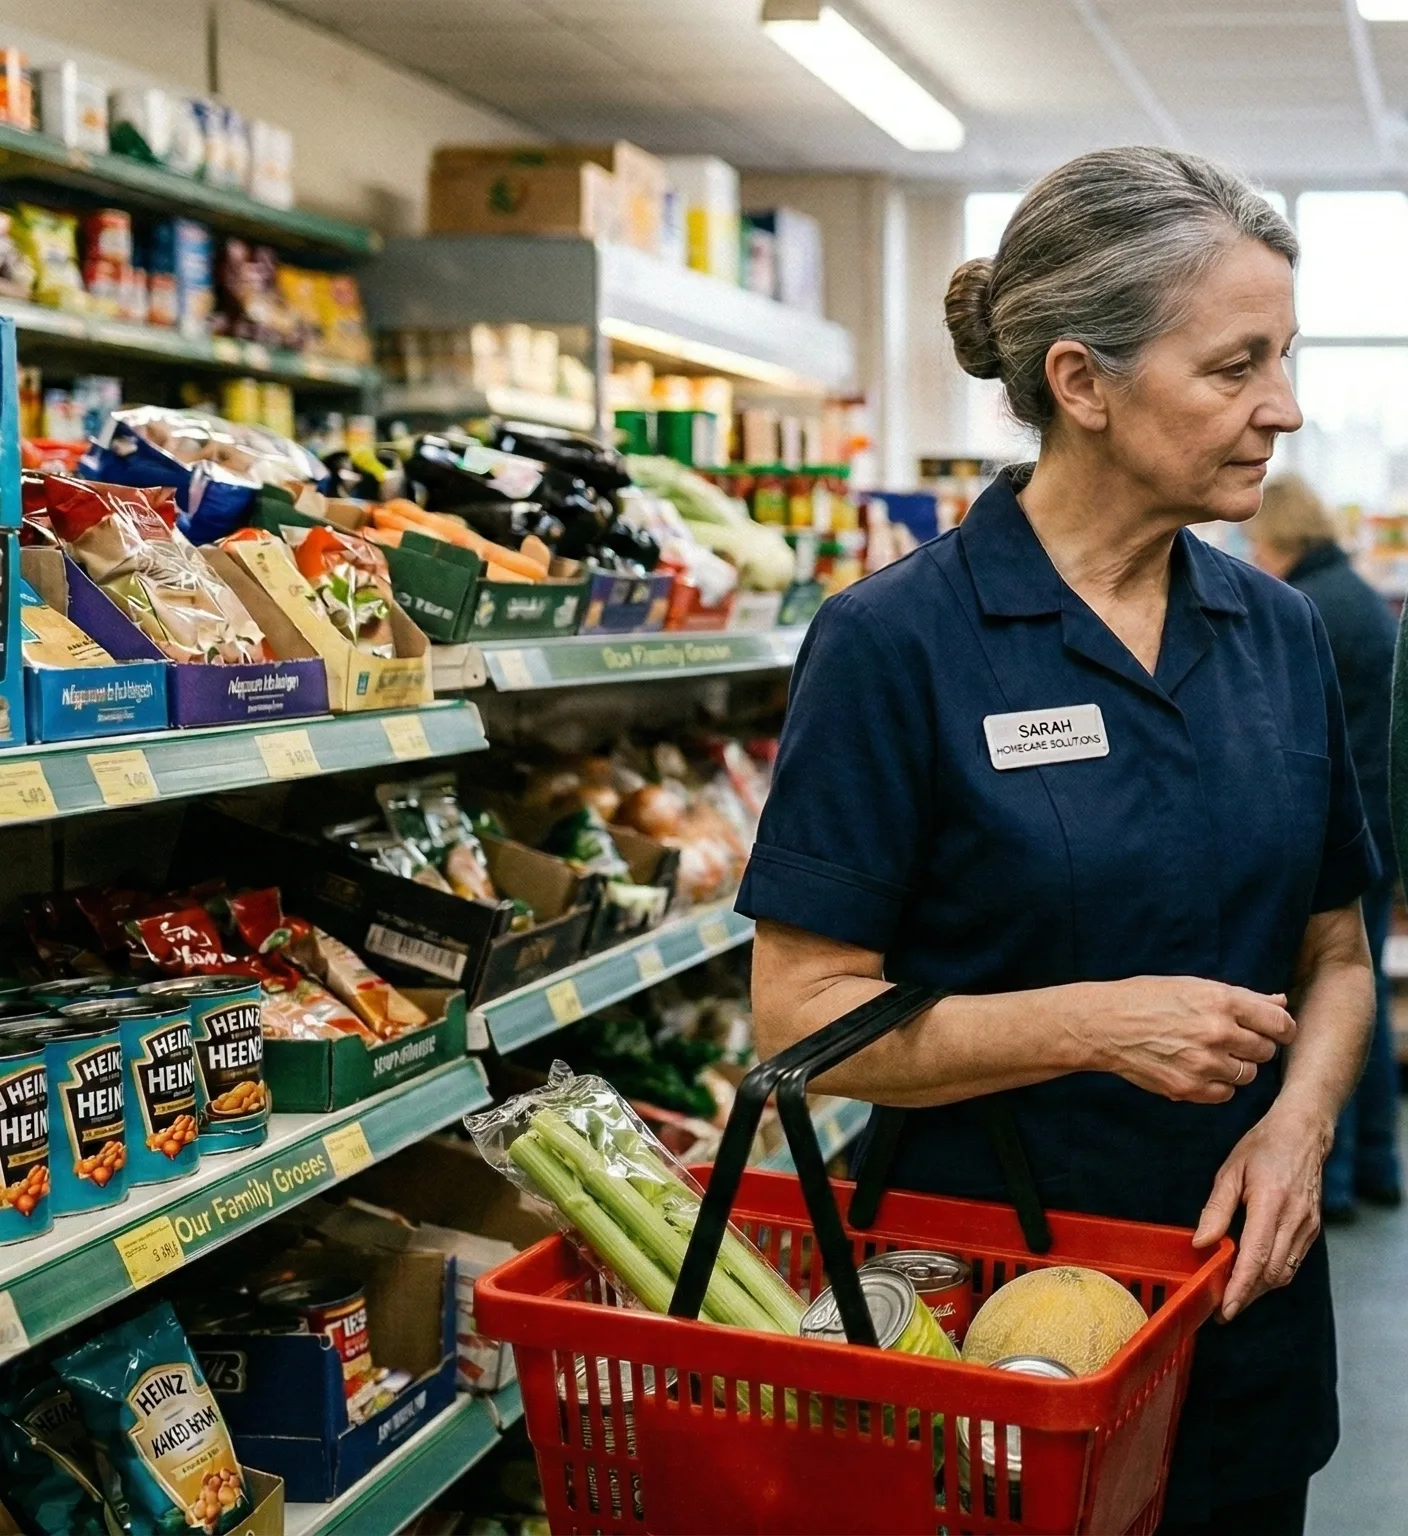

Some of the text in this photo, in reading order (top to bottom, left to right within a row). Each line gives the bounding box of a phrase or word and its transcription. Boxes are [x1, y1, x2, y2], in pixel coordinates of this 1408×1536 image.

[1018, 719, 1073, 738] SARAH
[211, 1008, 260, 1036] HEINZ
[82, 1050, 122, 1081] HEIN
[77, 1082, 124, 1119] HEIN
[174, 1211, 212, 1243] Our
[136, 1374, 187, 1416] HEINZ
